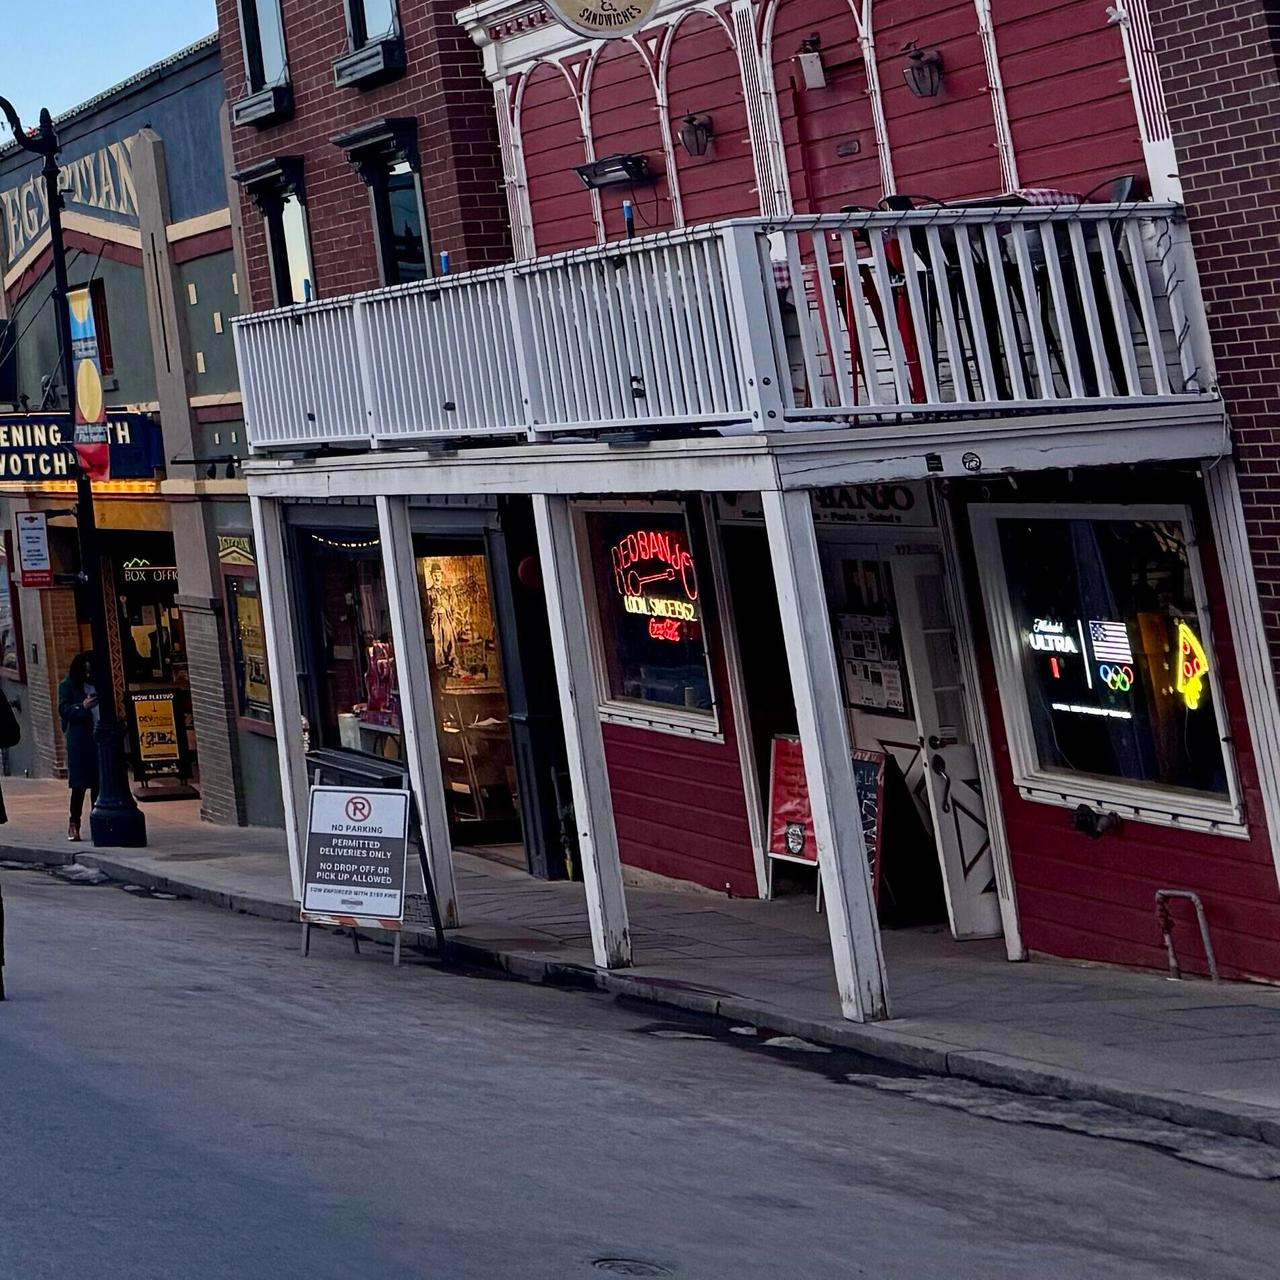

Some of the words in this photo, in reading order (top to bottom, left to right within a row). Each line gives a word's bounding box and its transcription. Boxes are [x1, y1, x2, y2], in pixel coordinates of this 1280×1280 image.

[579, 5, 642, 27] SANDWICHES
[125, 570, 146, 581] BOX
[1029, 633, 1078, 653] ULTRA
[346, 825, 383, 834] PARKING
[332, 838, 380, 848] PERMITTED
[320, 847, 367, 857] DELIVERIES
[369, 851, 392, 859] ONLY
[320, 862, 332, 870] NO
[334, 863, 357, 871] DROP
[360, 865, 375, 873] OFF
[352, 875, 392, 884] ALLOWED
